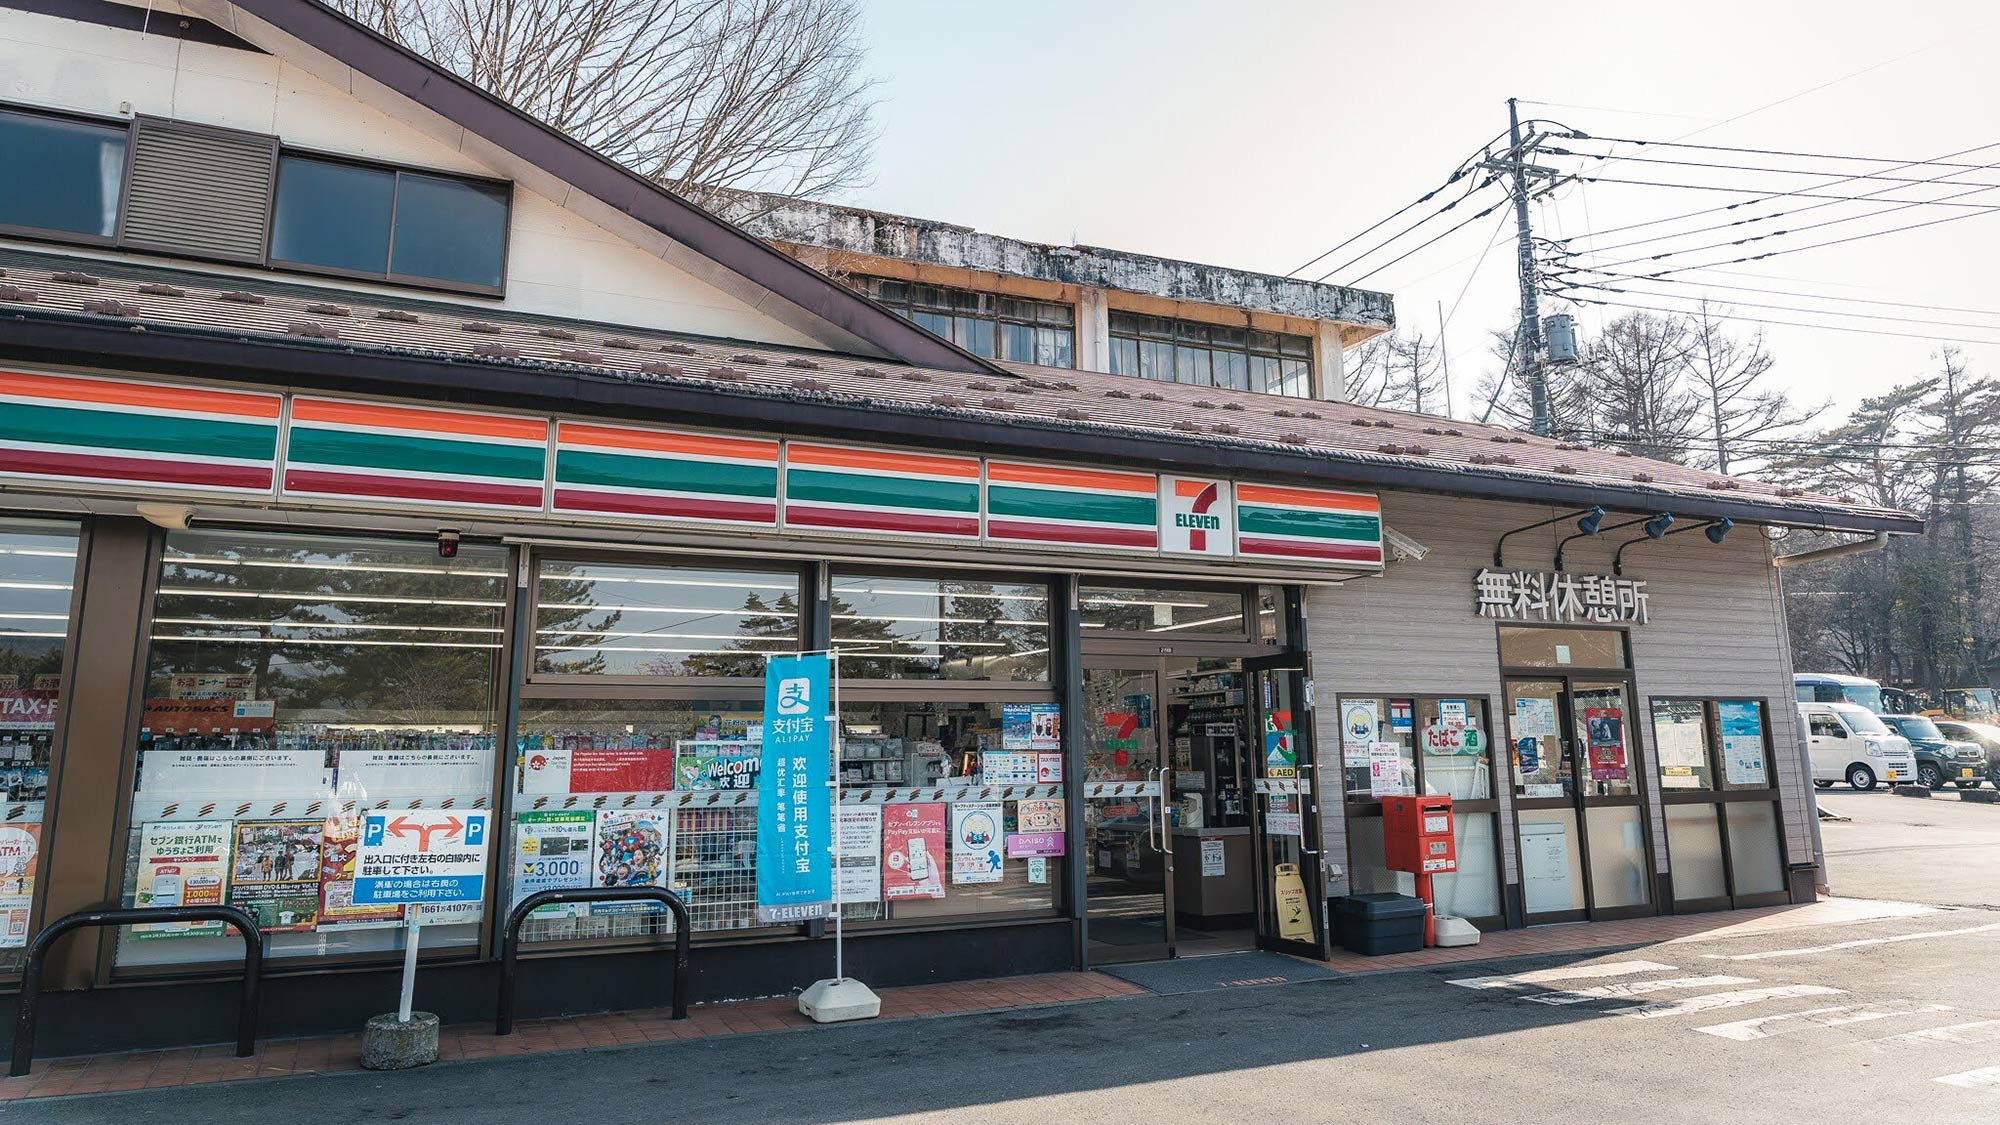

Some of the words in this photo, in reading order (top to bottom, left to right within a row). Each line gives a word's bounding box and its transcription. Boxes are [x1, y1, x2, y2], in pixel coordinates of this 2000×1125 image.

[1475, 567, 1649, 625] 無料休憩所
[154, 705, 229, 713] AUTOBACS
[772, 717, 814, 734] 支付宝
[775, 734, 810, 743] ALIPAY
[1428, 729, 1460, 747] たばこ
[1464, 729, 1478, 747] 酒
[708, 757, 762, 777] Welcom
[1277, 768, 1294, 777] AED
[792, 756, 811, 873] 欢迎使用支付宝
[368, 823, 382, 838] P
[468, 823, 481, 838] P
[150, 835, 222, 846] セブン銀行ATMで
[156, 846, 214, 856] ゆうちょご利用
[363, 853, 481, 865] 出入口に付き左右の白線内に
[362, 865, 434, 876] 駐車して下さい。
[535, 860, 579, 877] 3,000
